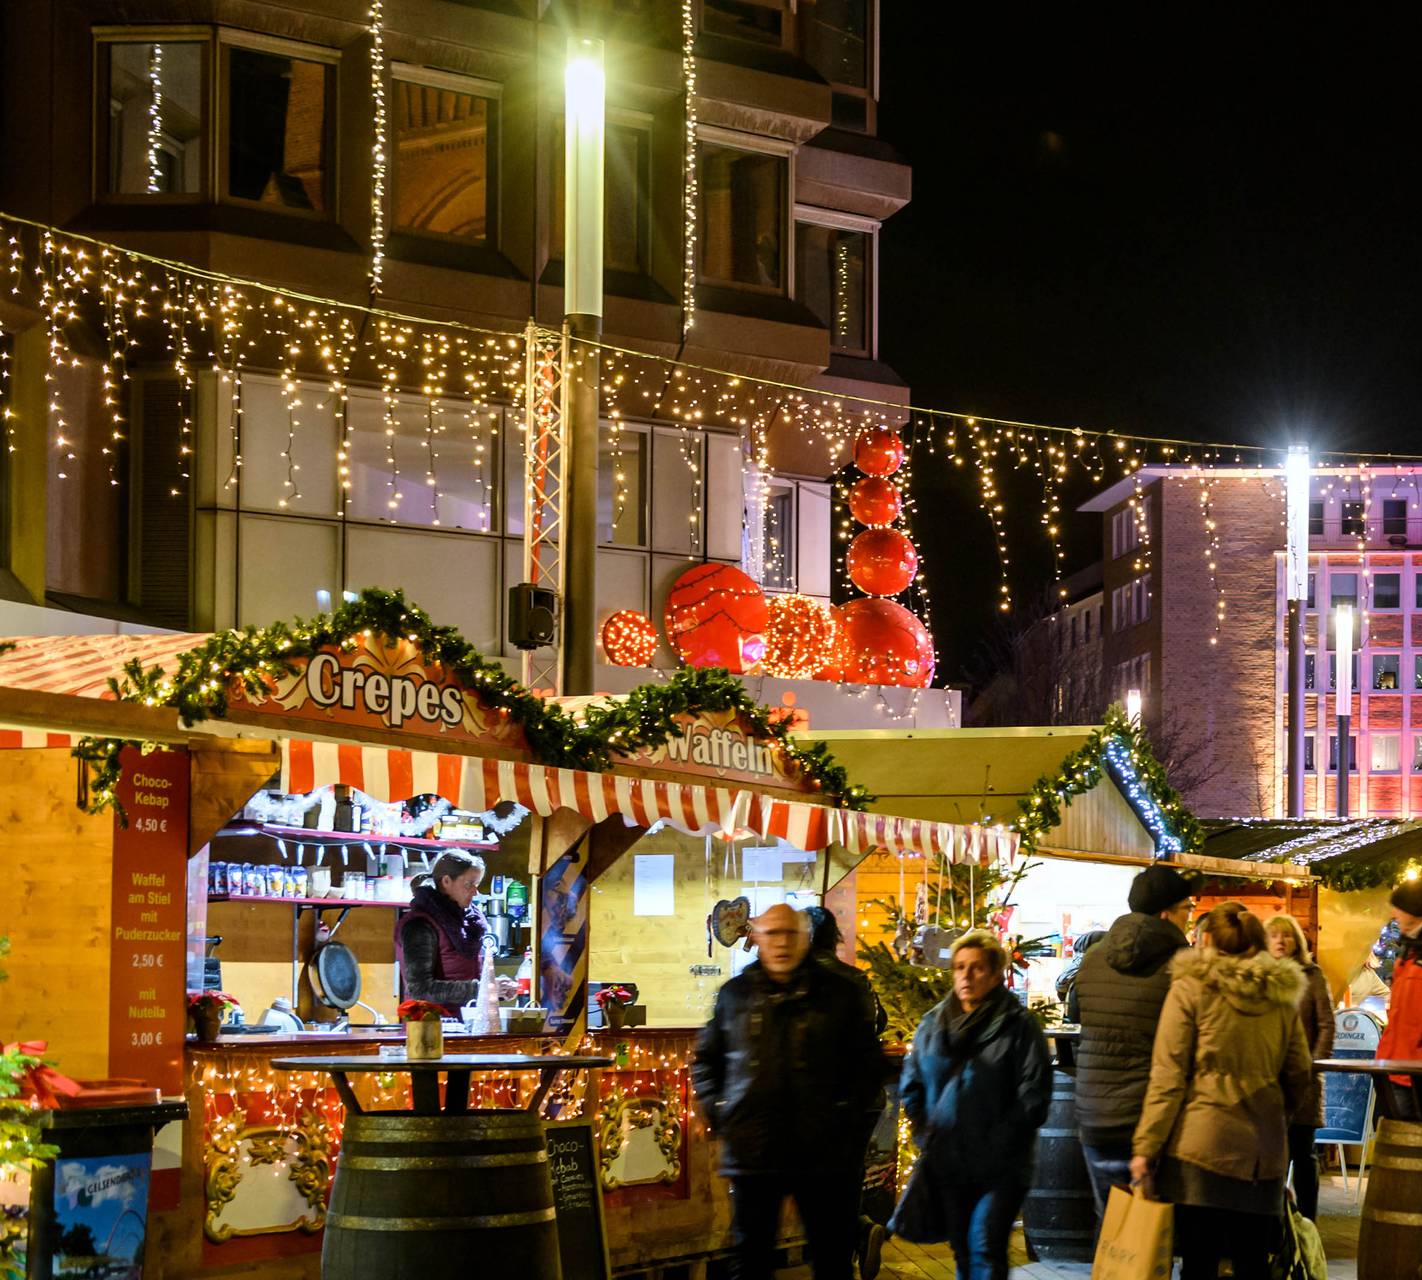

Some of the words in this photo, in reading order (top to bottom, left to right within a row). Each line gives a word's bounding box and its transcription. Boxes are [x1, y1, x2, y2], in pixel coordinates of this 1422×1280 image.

[306, 652, 464, 728] Crepes
[666, 724, 773, 776] Waffeln
[133, 773, 172, 789] Choco-
[134, 792, 169, 809] Kebap
[135, 818, 158, 833] 4,50
[160, 819, 167, 832] €
[131, 873, 165, 887] Waffel
[128, 893, 145, 904] am
[147, 892, 171, 905] Stiel
[140, 911, 158, 923] mit
[115, 927, 181, 942] Puderzucker
[132, 954, 154, 969] 2,50
[156, 954, 164, 967] €
[139, 988, 156, 1001] mit
[128, 1006, 166, 1019] Nutella
[131, 1032, 154, 1047] 3,00
[155, 1032, 163, 1046] €
[1334, 1031, 1366, 1042] RDINGER
